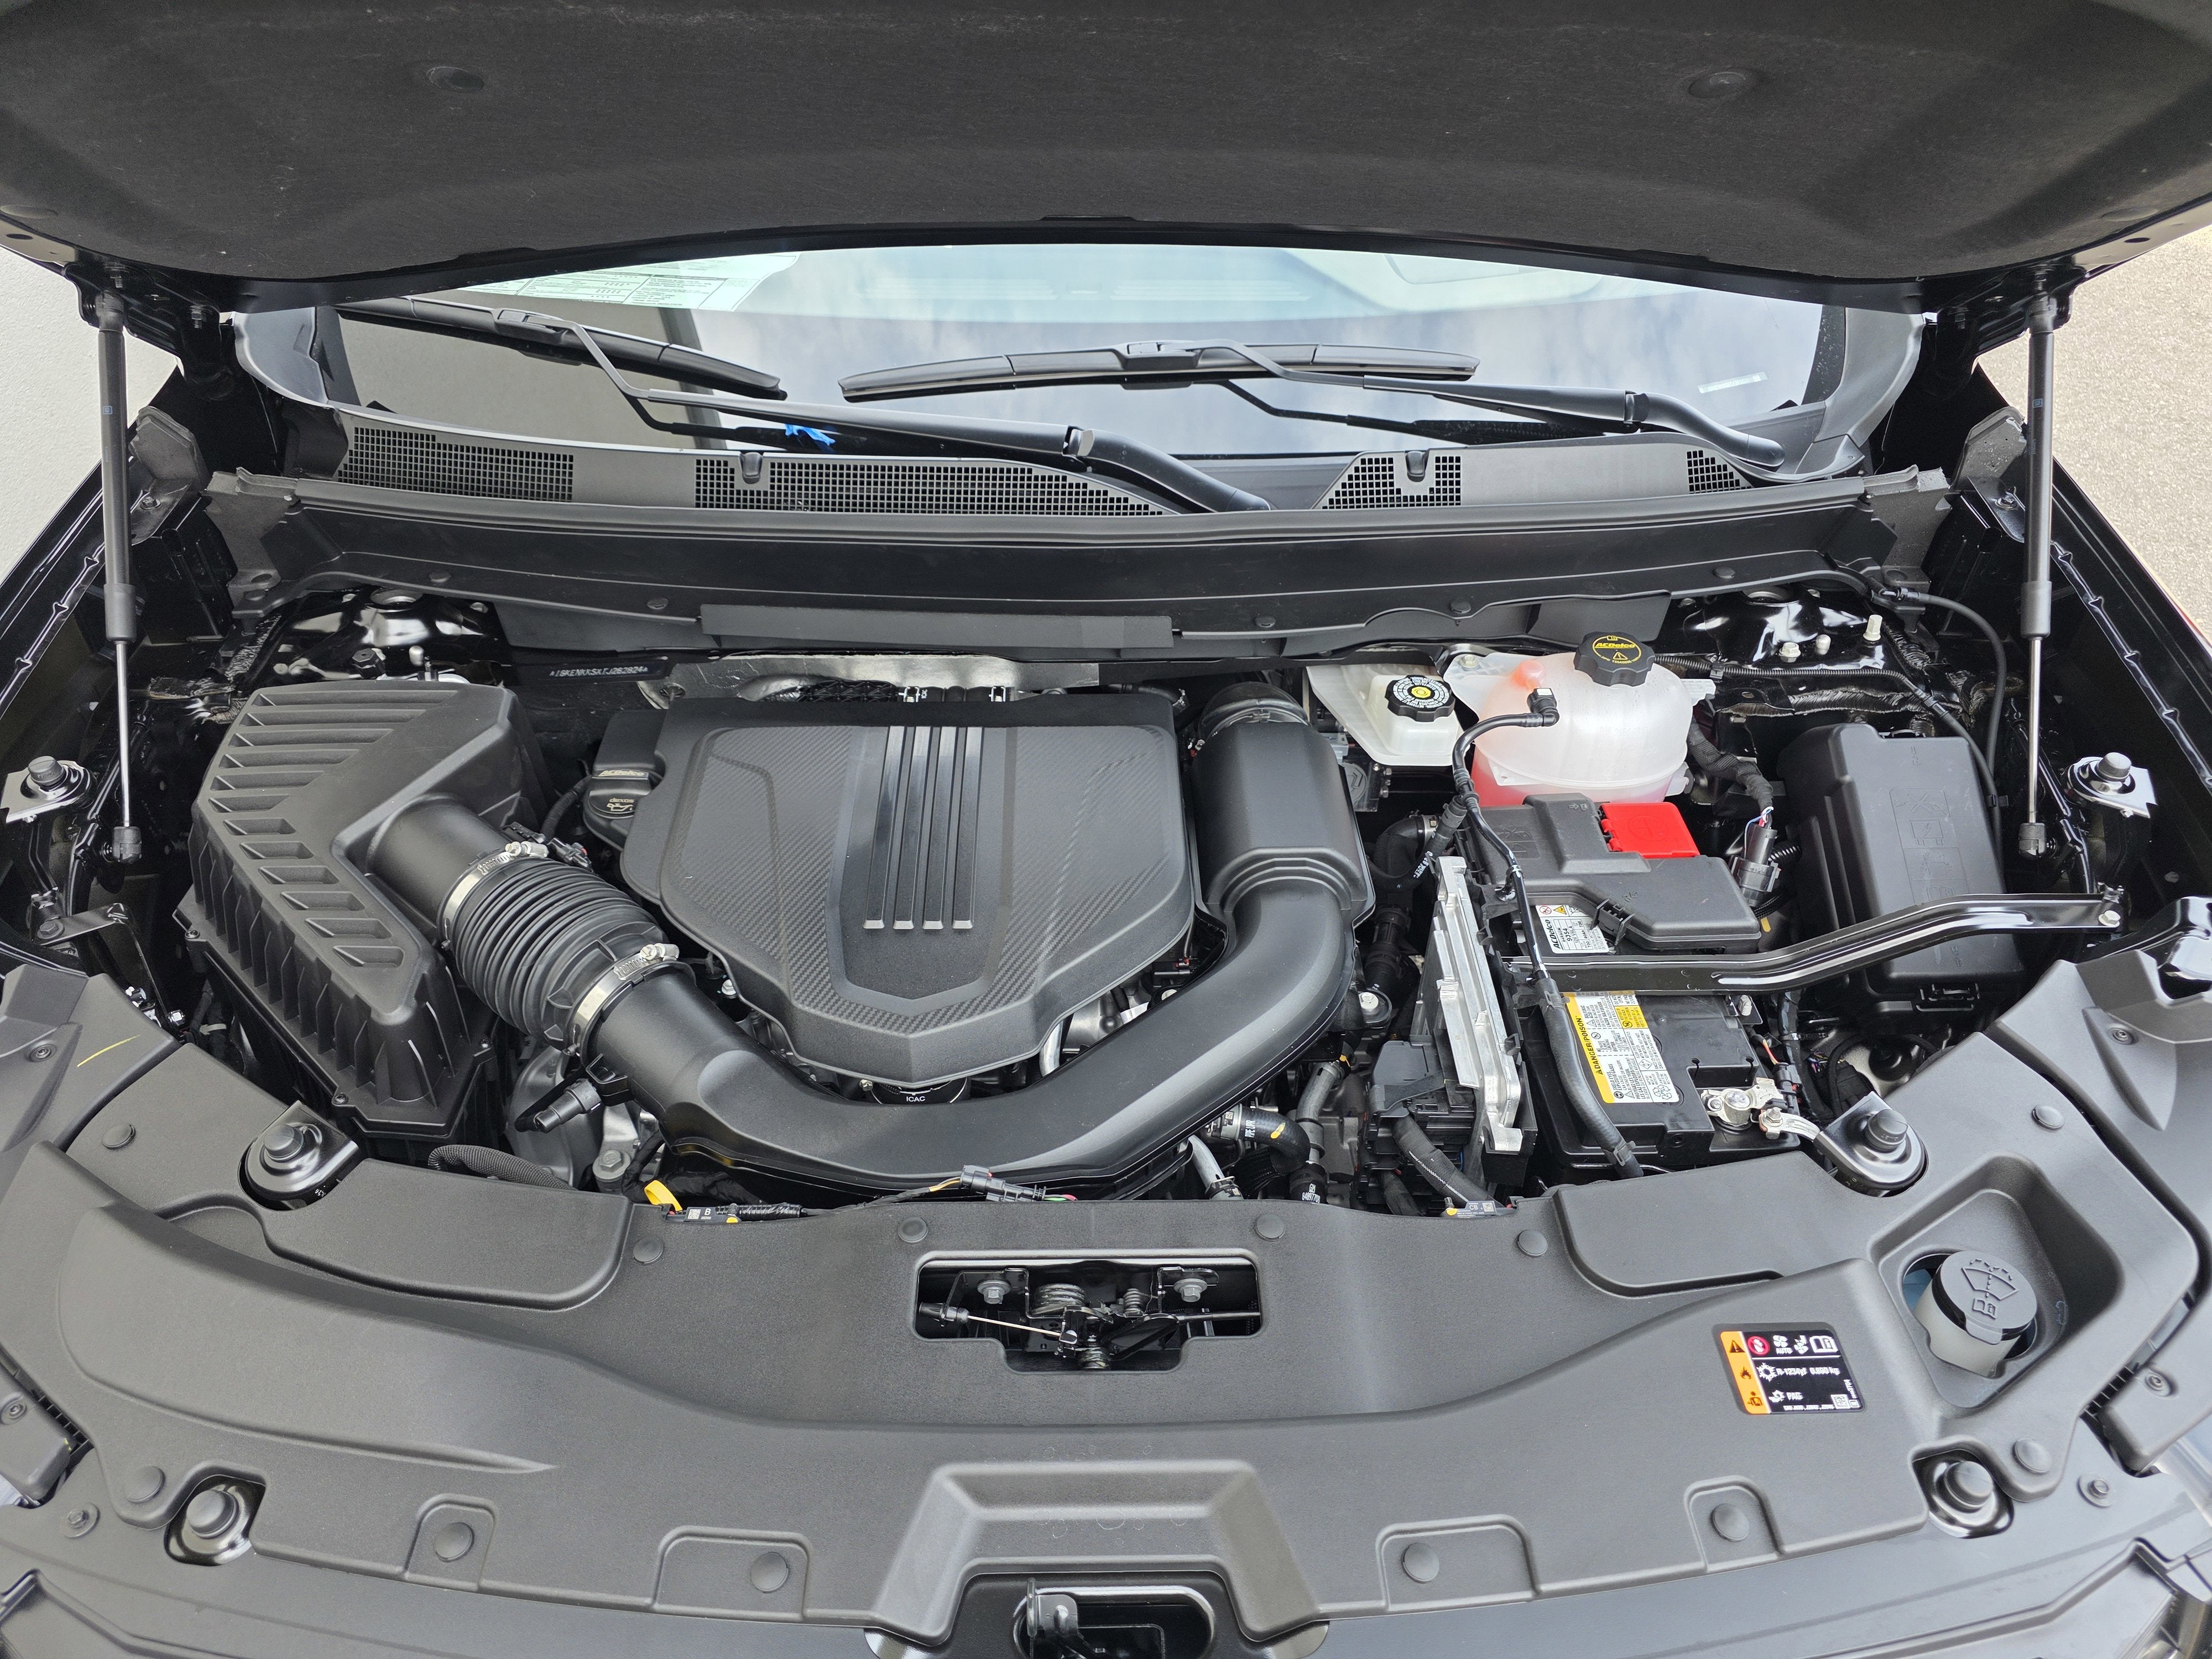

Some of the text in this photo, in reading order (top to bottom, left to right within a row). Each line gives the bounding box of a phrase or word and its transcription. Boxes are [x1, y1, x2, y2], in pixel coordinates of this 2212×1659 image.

[1545, 920, 1559, 948] ACDelco
[1563, 928, 1572, 941] 9354
[1577, 1018, 1600, 1068] DANGER/POISON
[1786, 1392, 1803, 1400] PAG
